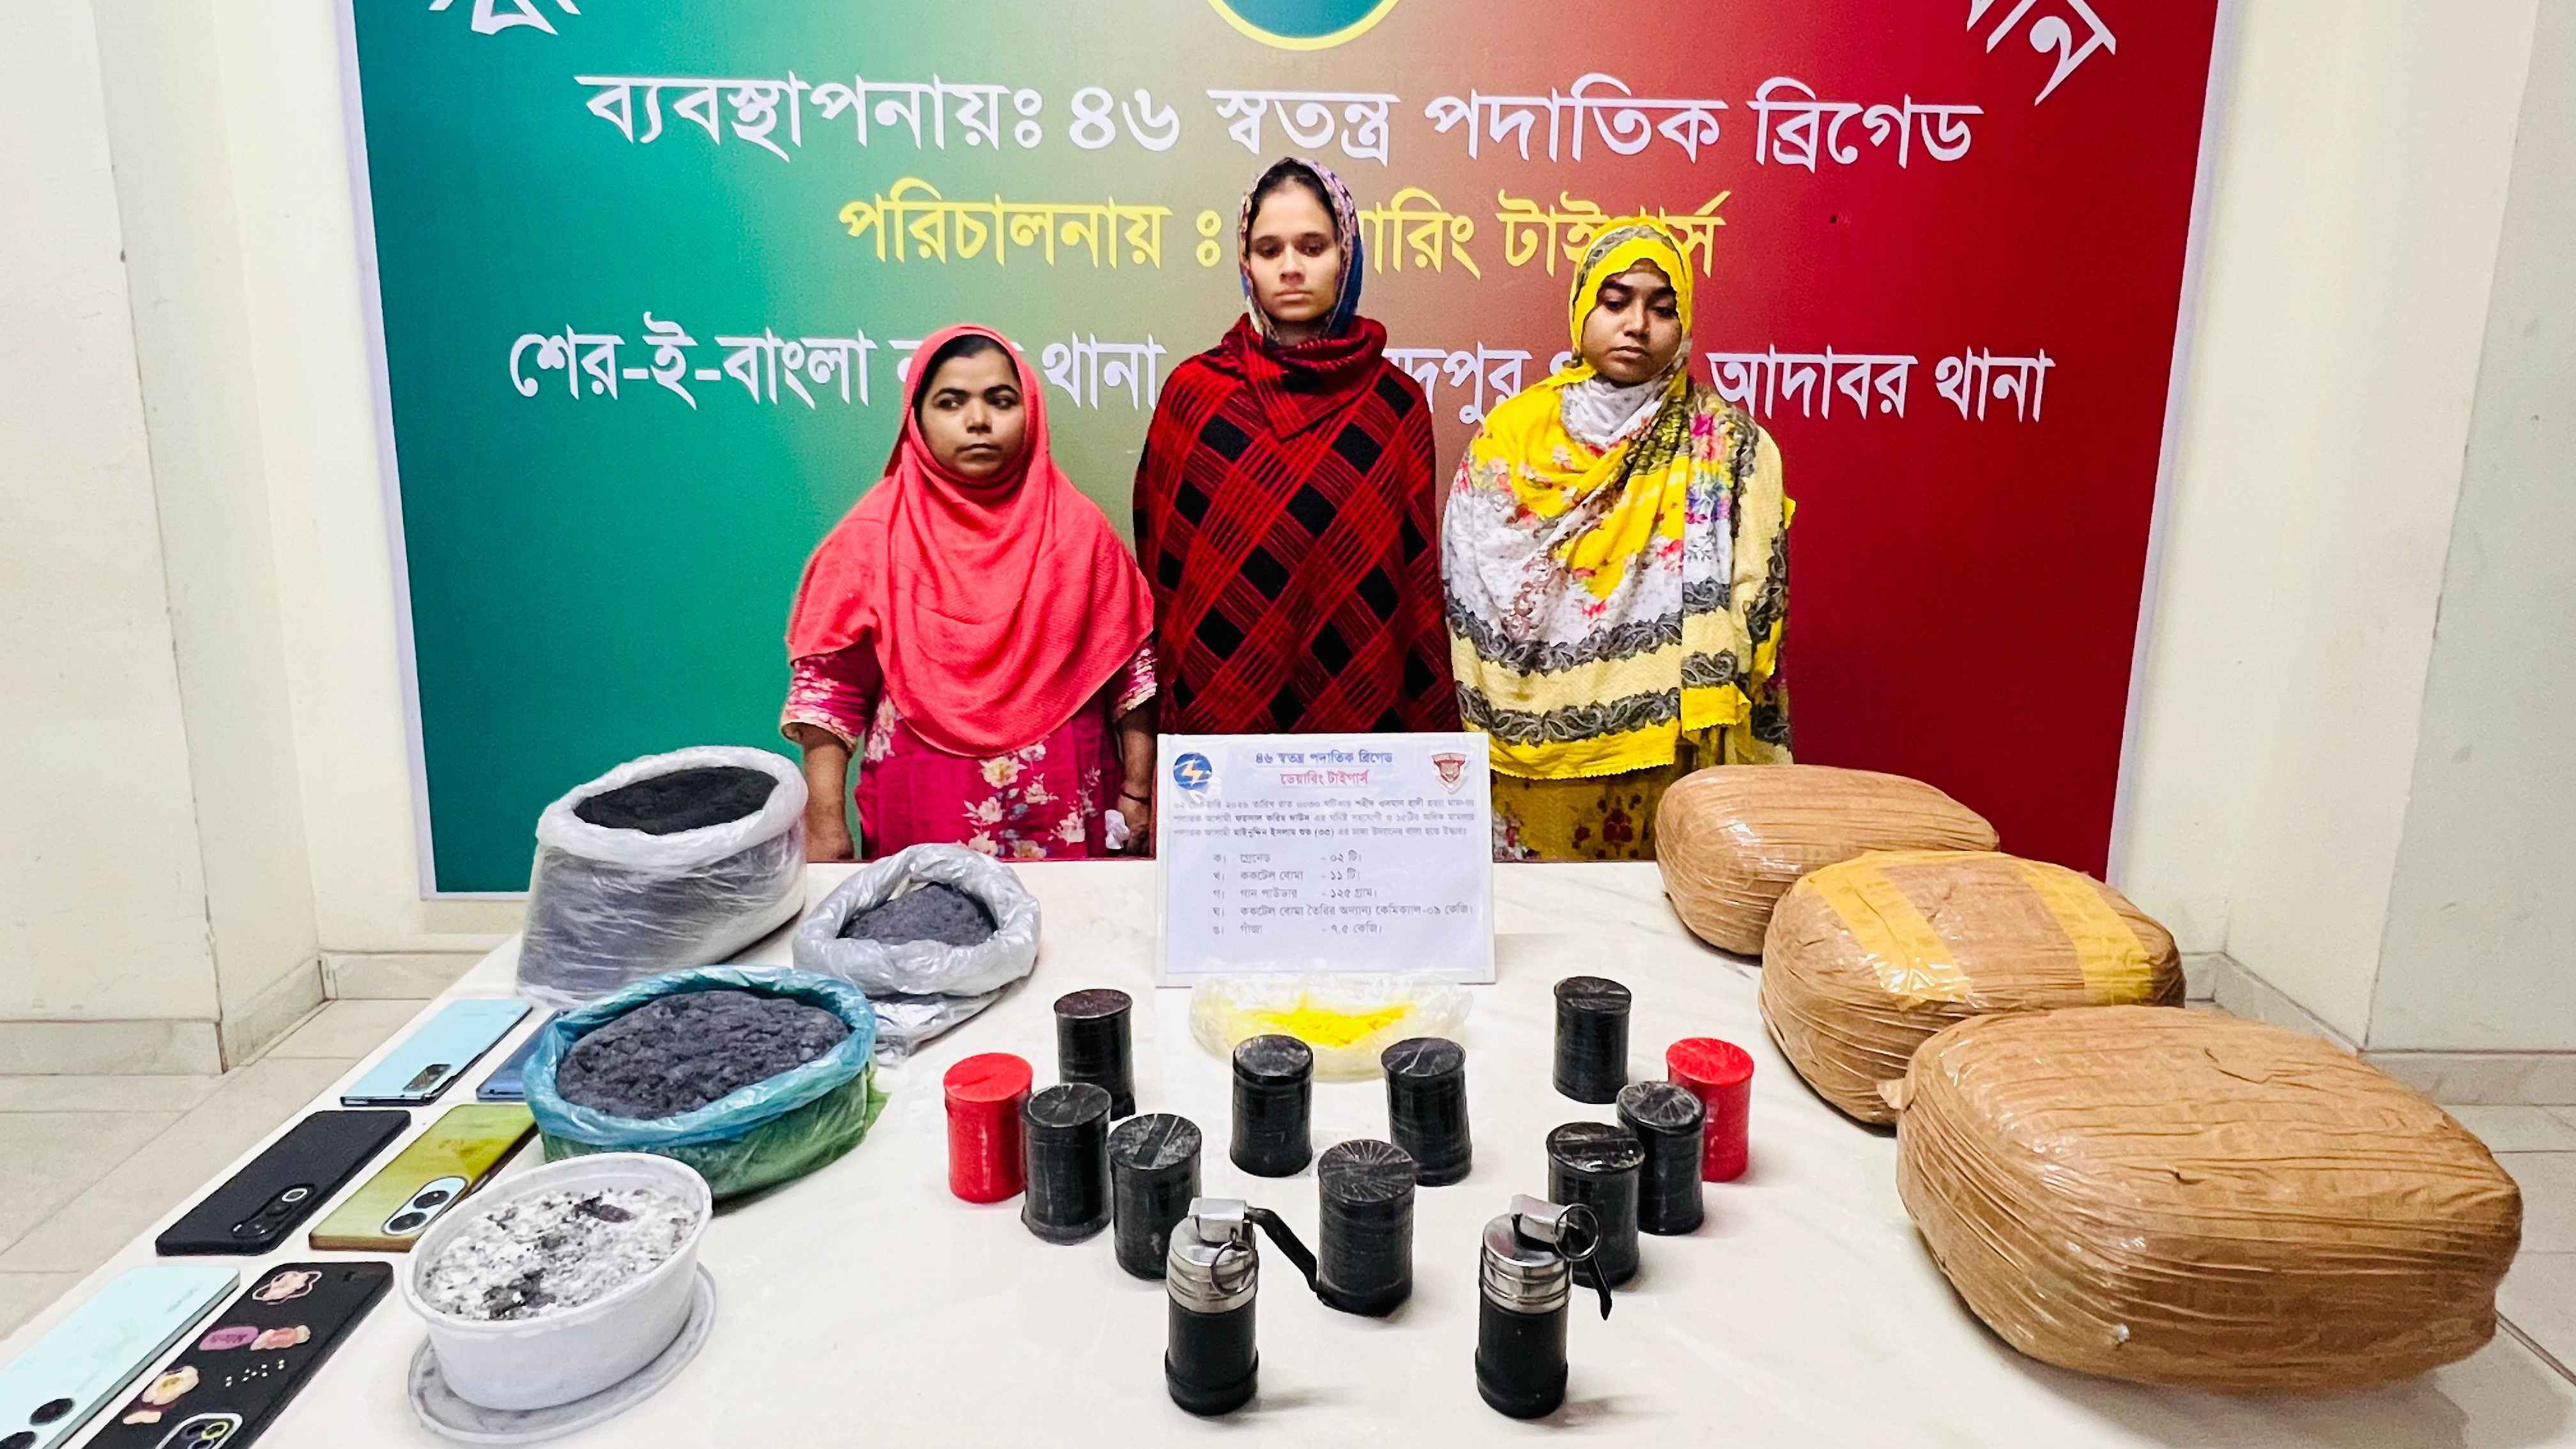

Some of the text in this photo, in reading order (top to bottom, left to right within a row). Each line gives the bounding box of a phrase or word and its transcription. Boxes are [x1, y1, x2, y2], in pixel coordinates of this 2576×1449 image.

[574, 70, 1984, 171] ব্যবস্থাপনায়ঃ ৪৬ স্বতন্ত্র পদাতিক ব্রিগেড
[839, 177, 1173, 268] পরিচালনায়
[510, 311, 878, 410] শের-ই-বাংলা
[1041, 330, 1168, 410] থানা
[1706, 343, 1919, 420] আদাবর
[1935, 346, 2055, 424] থানা
[1255, 752, 1273, 764] ৪৬
[1309, 749, 1354, 764] পদাতিক
[1358, 749, 1393, 764] ব্রিগেড
[1280, 771, 1369, 786] ডেয়ারিং টাইগার্স
